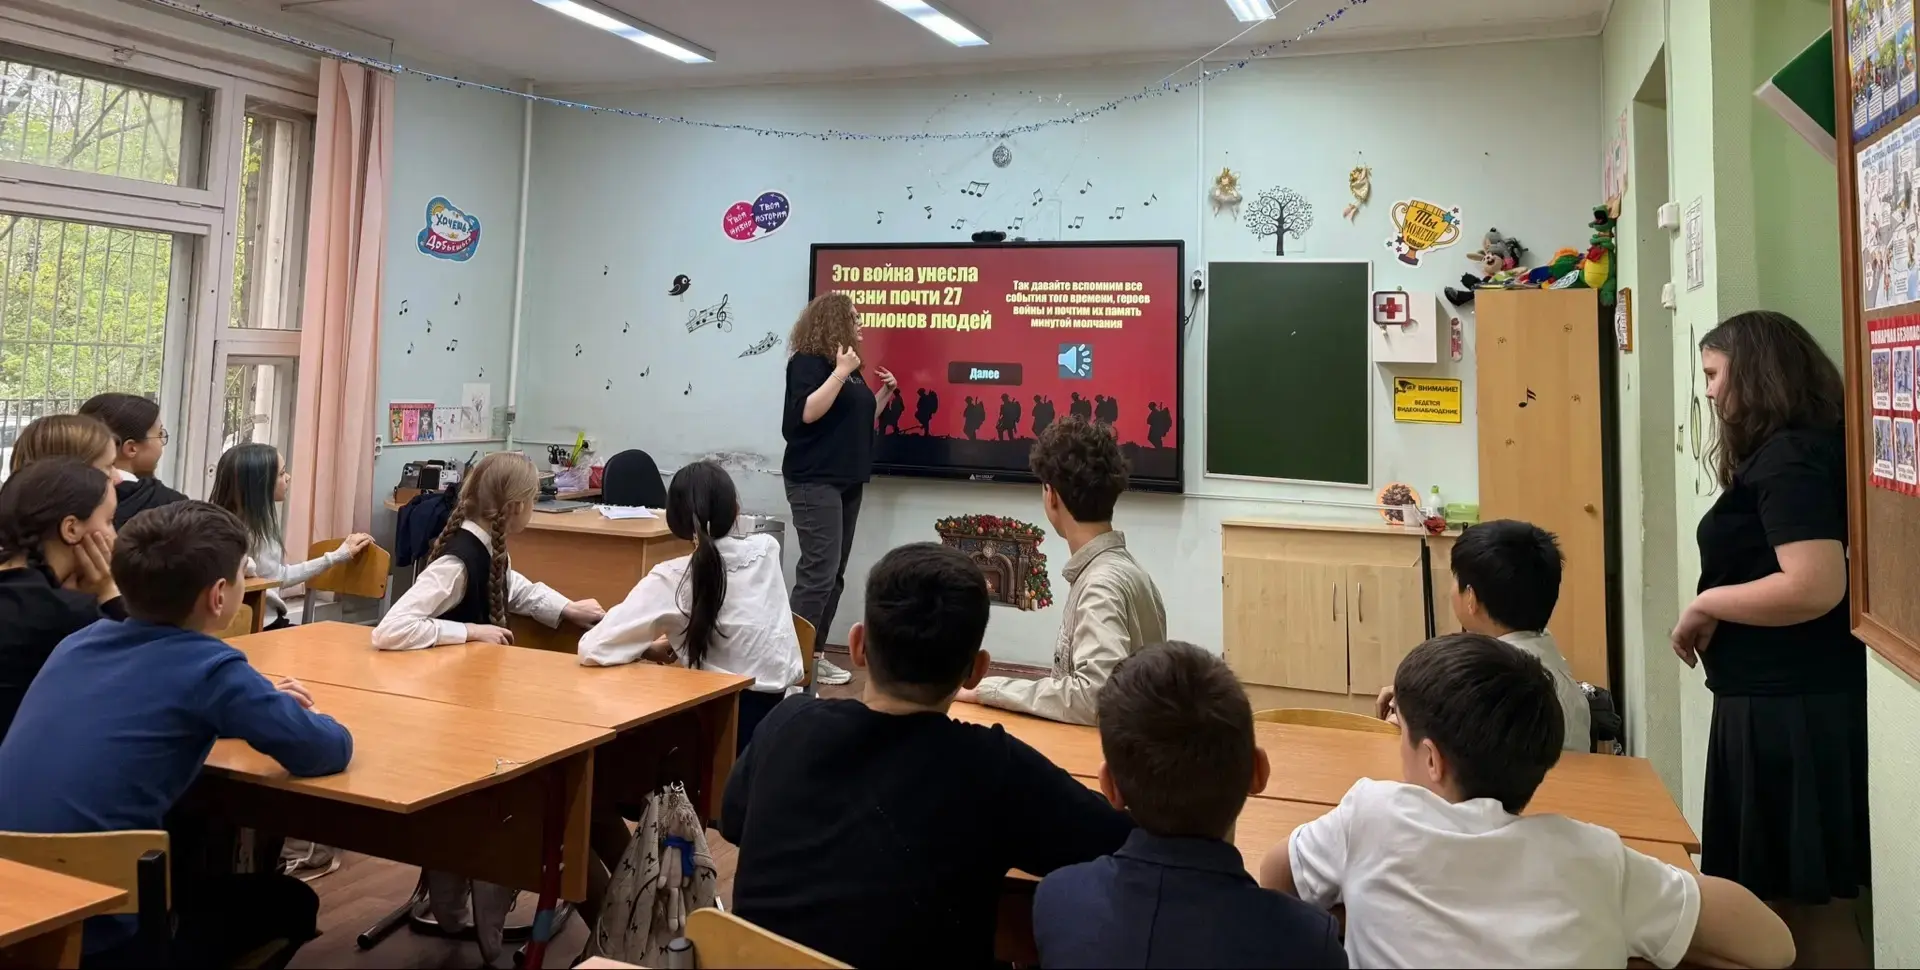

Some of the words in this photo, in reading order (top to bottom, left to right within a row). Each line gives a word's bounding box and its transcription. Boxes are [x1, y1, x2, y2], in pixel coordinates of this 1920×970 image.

[832, 264, 860, 282] Это
[863, 263, 914, 282] война
[917, 266, 979, 284] унесла
[1013, 280, 1029, 291] Так
[1031, 280, 1071, 292] давайте
[1072, 281, 1124, 291] вспомним
[1125, 282, 1143, 291] все
[832, 289, 887, 305] изни
[890, 290, 940, 305] почти
[943, 287, 963, 306] 27
[1006, 293, 1047, 303] события
[1048, 294, 1069, 303] того
[1070, 294, 1115, 304] времени,
[1117, 294, 1150, 304] героев
[1013, 304, 1045, 315] войны
[1047, 306, 1054, 315] и
[1055, 306, 1090, 316] почтим
[1092, 306, 1104, 316] их
[1105, 307, 1142, 317] память
[930, 310, 992, 332] людей
[1031, 317, 1072, 328] минутой
[1073, 319, 1123, 328] молчания
[970, 367, 1000, 380] Далее
[1417, 385, 1459, 393] ВНИМАНИЕ!
[1397, 406, 1458, 415] ВИДЕОНАБЛЮДЕНИЕ
